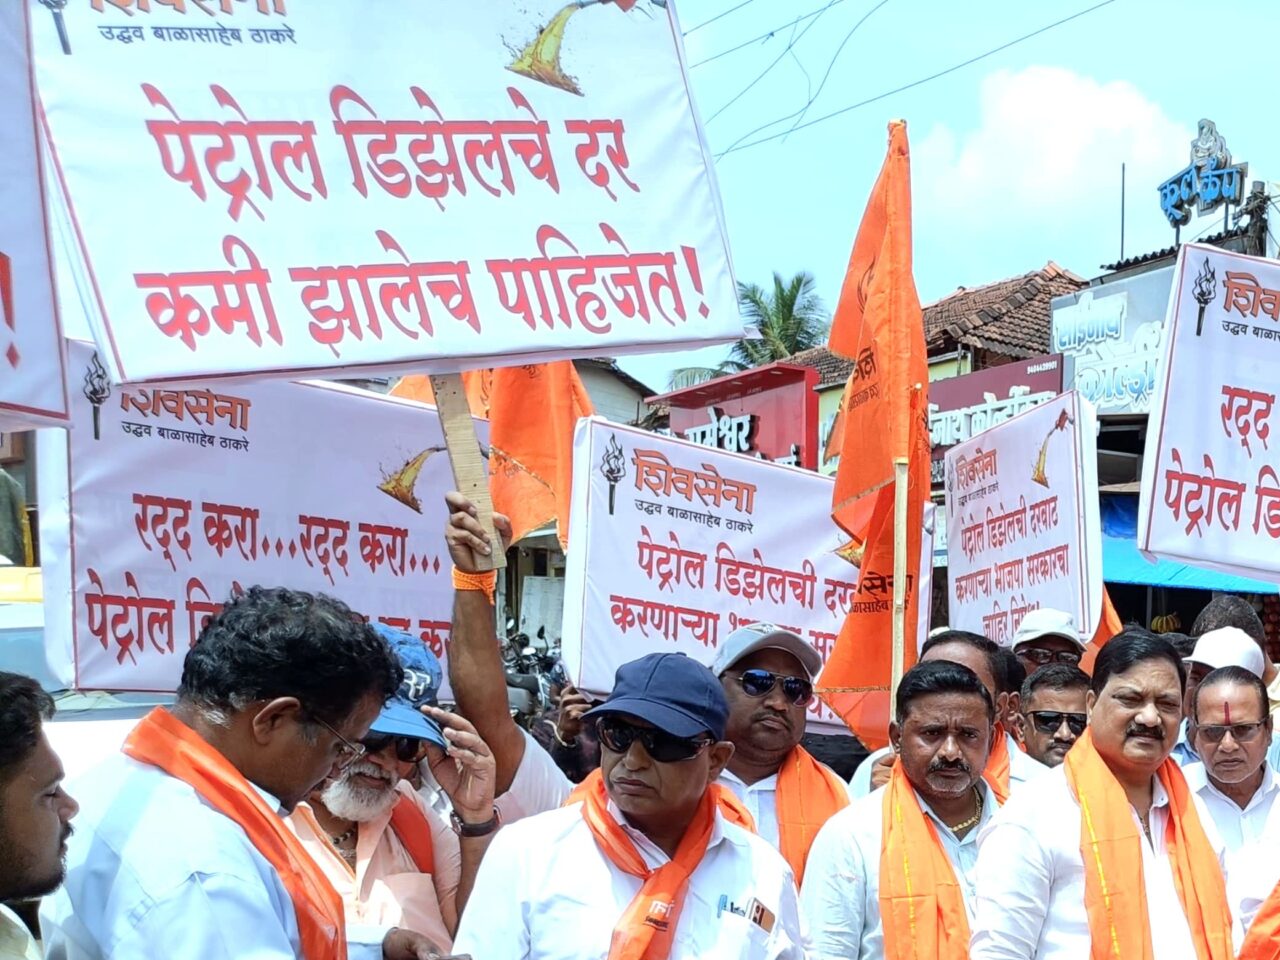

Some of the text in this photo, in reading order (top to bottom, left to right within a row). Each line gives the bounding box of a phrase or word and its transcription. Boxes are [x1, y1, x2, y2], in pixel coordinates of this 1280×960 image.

[98, 22, 298, 46] उद्धव बाळासाहेब ठाकरे
[140, 83, 641, 221] पेट्रोल डिझेलचे दर
[133, 235, 284, 352] कमी
[290, 229, 482, 359] झालेच
[487, 222, 711, 334] पाहिजेत!
[1222, 319, 1249, 337] उद्धव
[121, 420, 250, 452] उद्धव बाळासाहेब ठाकरे
[955, 447, 998, 492] शिवसेना
[631, 448, 757, 515] शिवसेना
[1164, 448, 1245, 539] पेट्रोल
[634, 499, 754, 535] उद्धव बाळासाहेब ठाकरे
[961, 495, 1059, 564] पेट्रोल डिझेलची दरवाढ
[637, 525, 708, 593] पेट्रोल
[715, 542, 818, 610] डिझेलची
[994, 558, 1025, 592] भाजपा
[1026, 543, 1070, 586] सरकारचा
[84, 567, 176, 665] पेट्रोल
